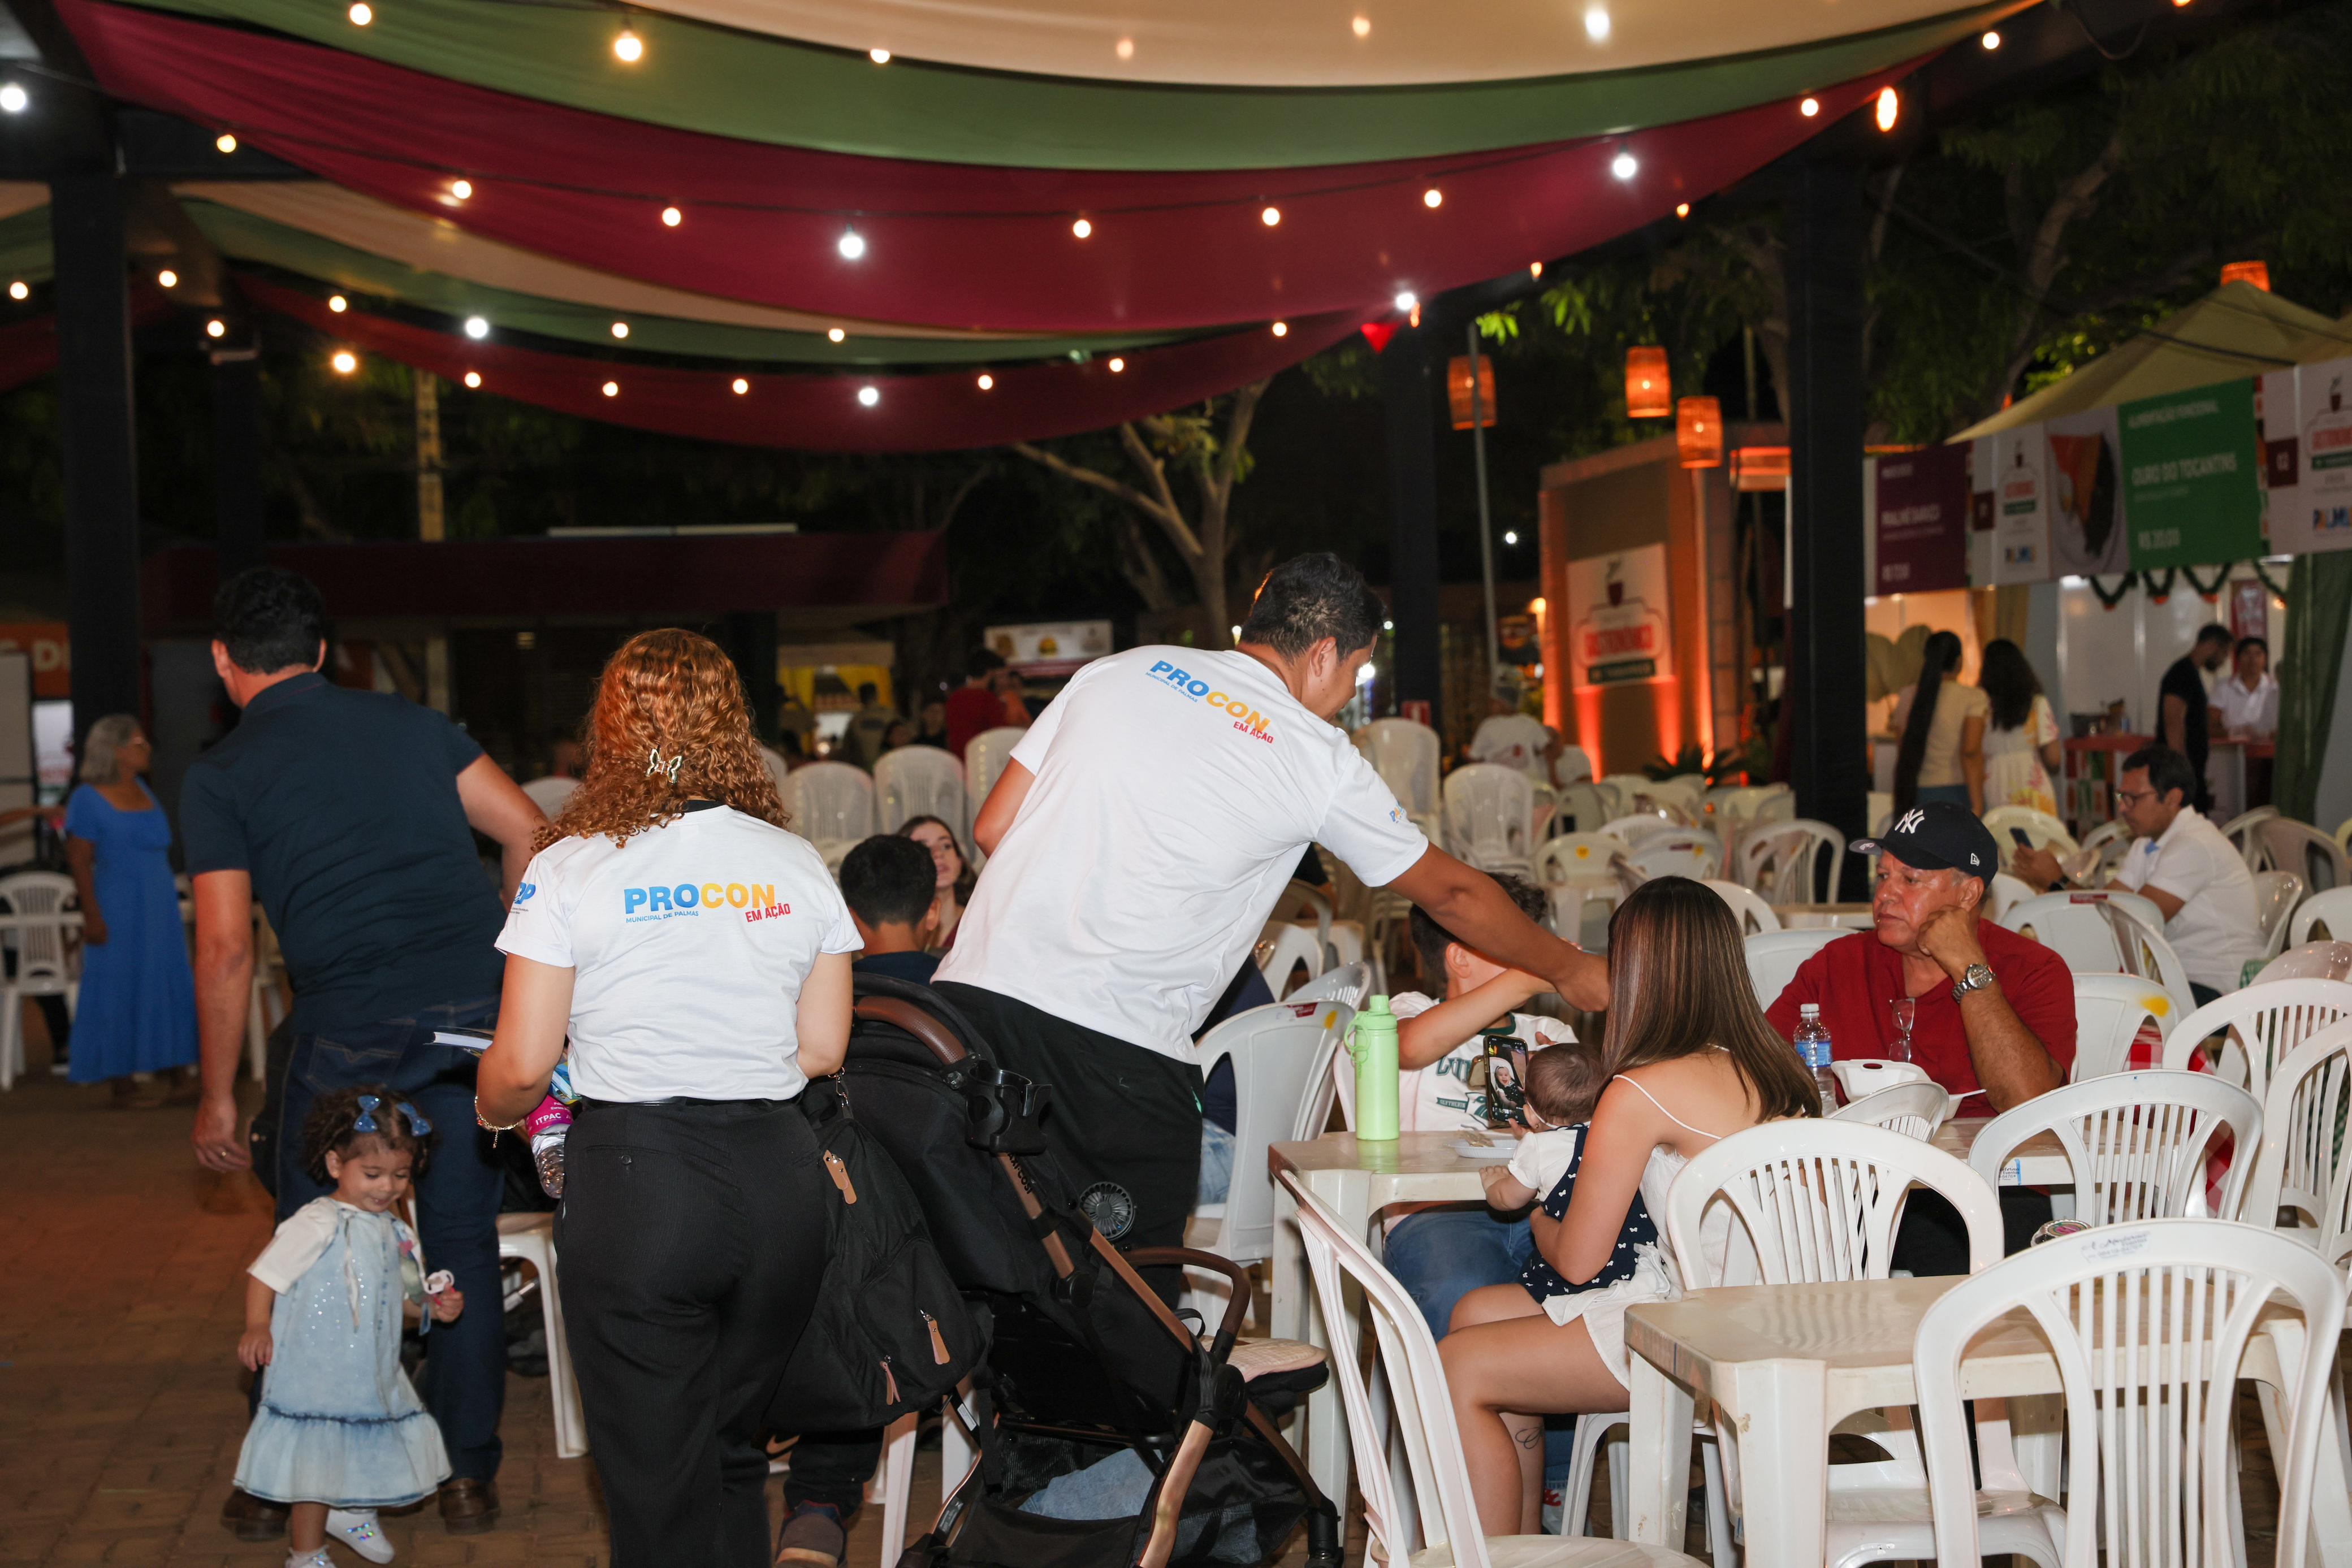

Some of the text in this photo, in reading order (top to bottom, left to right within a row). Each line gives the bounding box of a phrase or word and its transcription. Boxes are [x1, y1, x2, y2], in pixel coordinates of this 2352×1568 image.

[1145, 672, 1170, 686] MUNICIPAL
[1178, 689, 1198, 703] PALMAS
[1150, 660, 1270, 732] PROCON
[1233, 721, 1274, 744] EM AÇÃO
[624, 883, 776, 914] PROCON
[626, 913, 662, 923] MUNICIPAL
[746, 903, 791, 922] EM AÇÃO
[1439, 1099, 1466, 1108] SLYTHERIN
[535, 1113, 561, 1125] ITPAC
